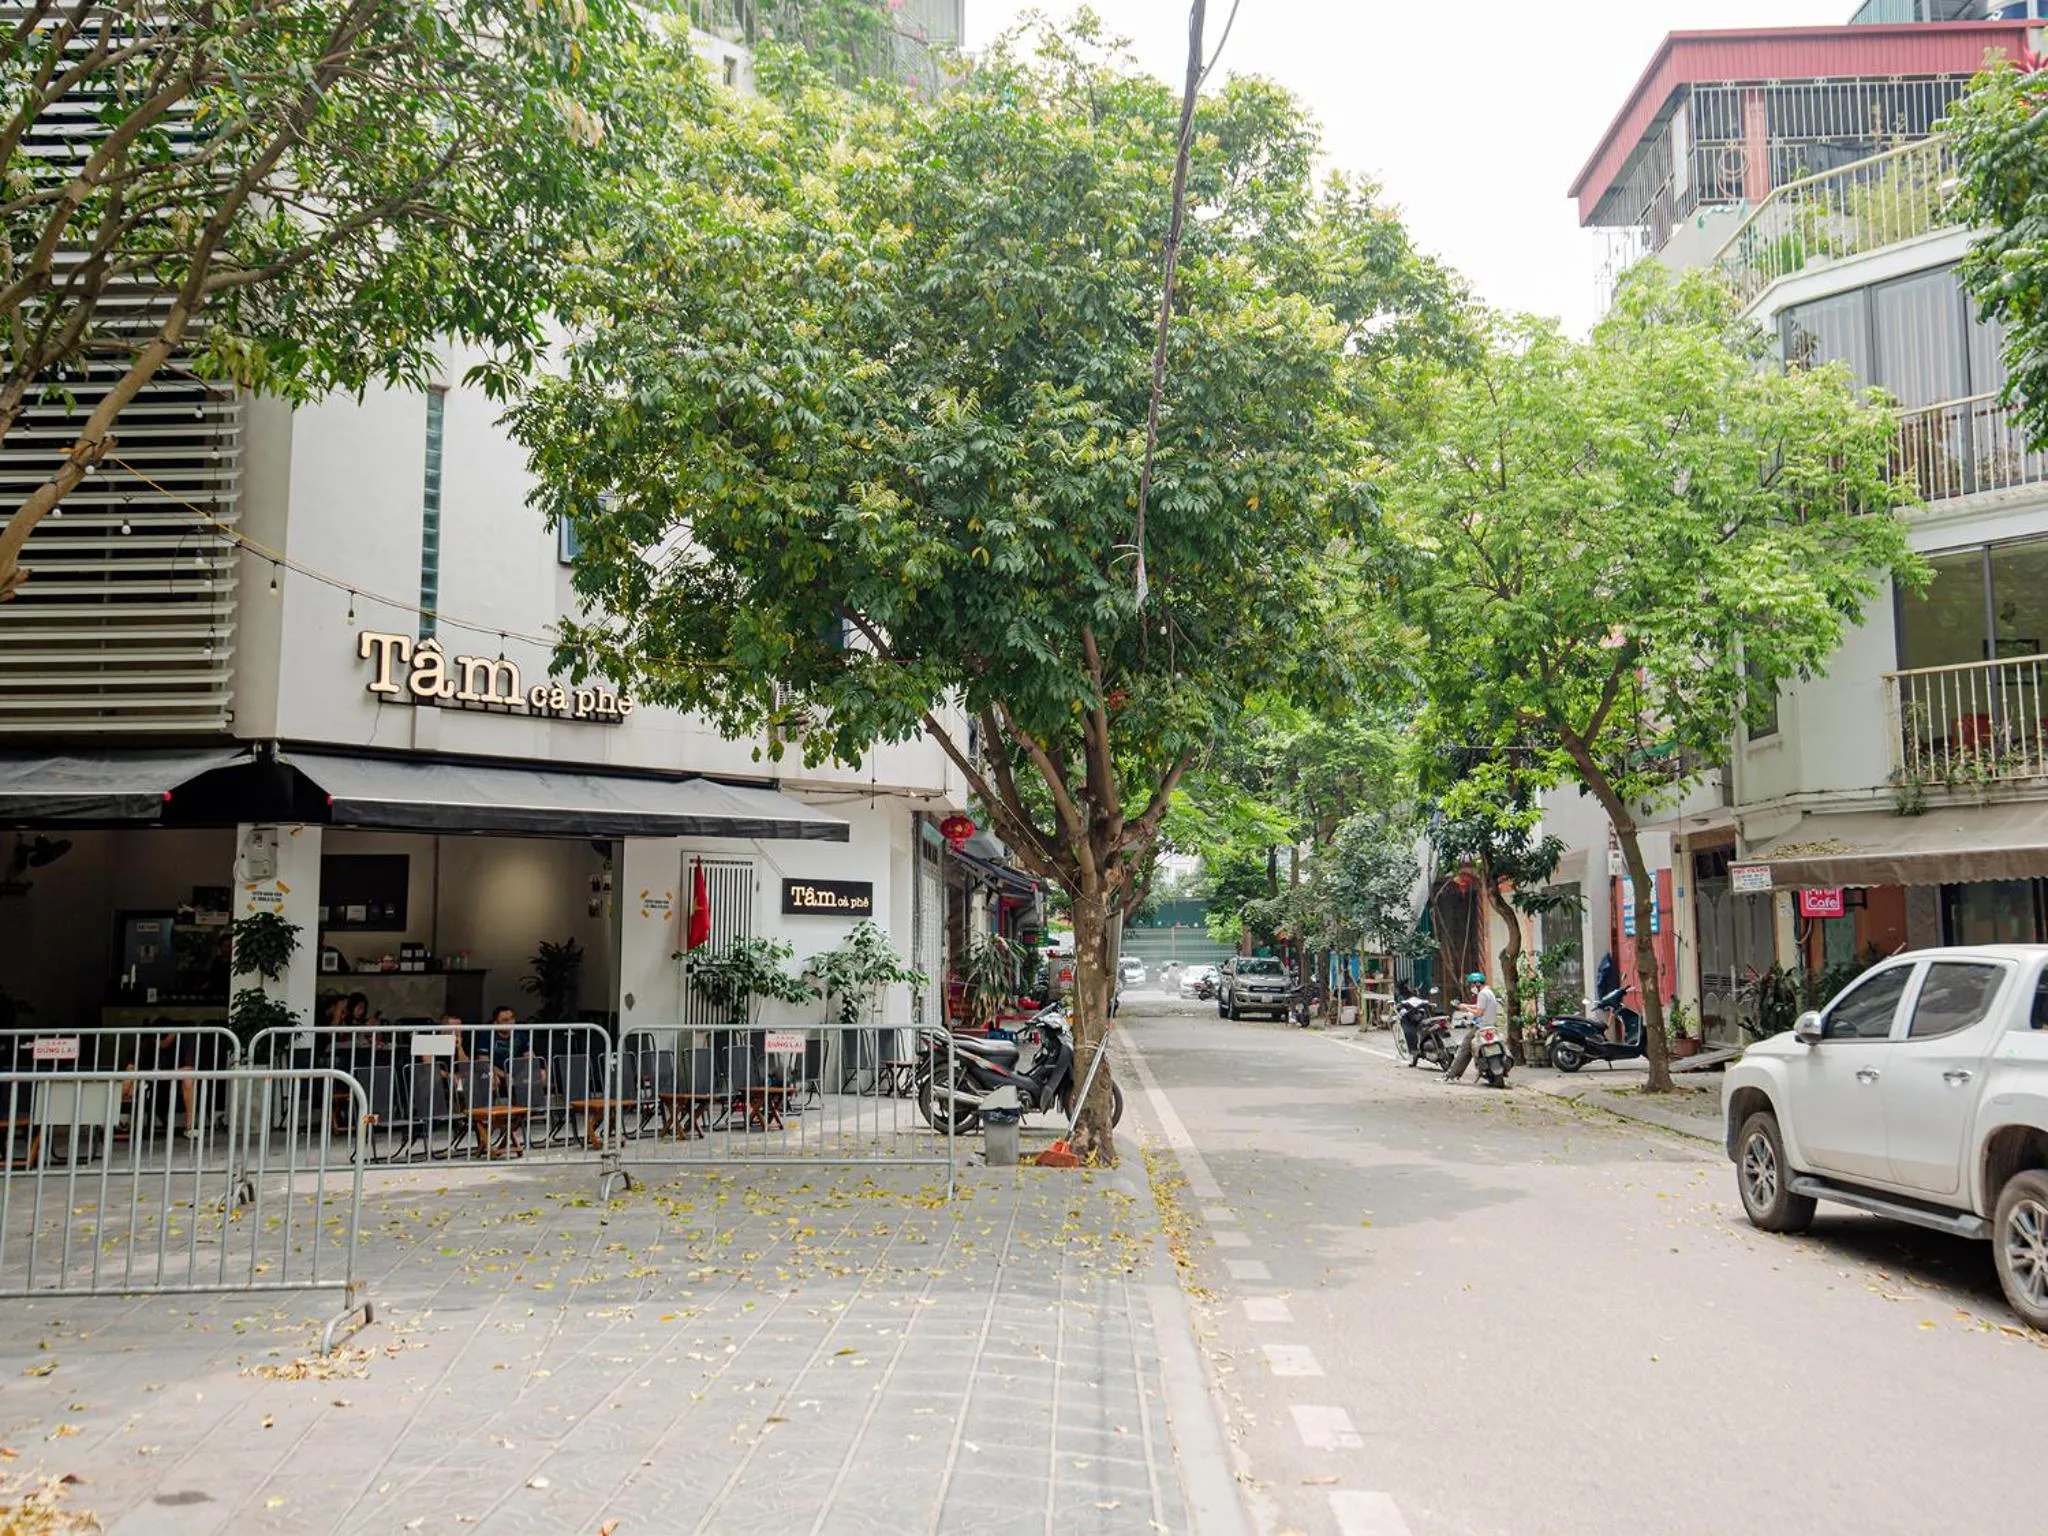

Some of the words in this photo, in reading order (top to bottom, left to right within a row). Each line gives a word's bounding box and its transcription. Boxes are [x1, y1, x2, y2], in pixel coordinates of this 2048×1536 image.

[359, 631, 526, 705] Tâm
[530, 682, 569, 709] cà
[791, 886, 837, 907] Tâm
[1808, 897, 1837, 908] Cafe
